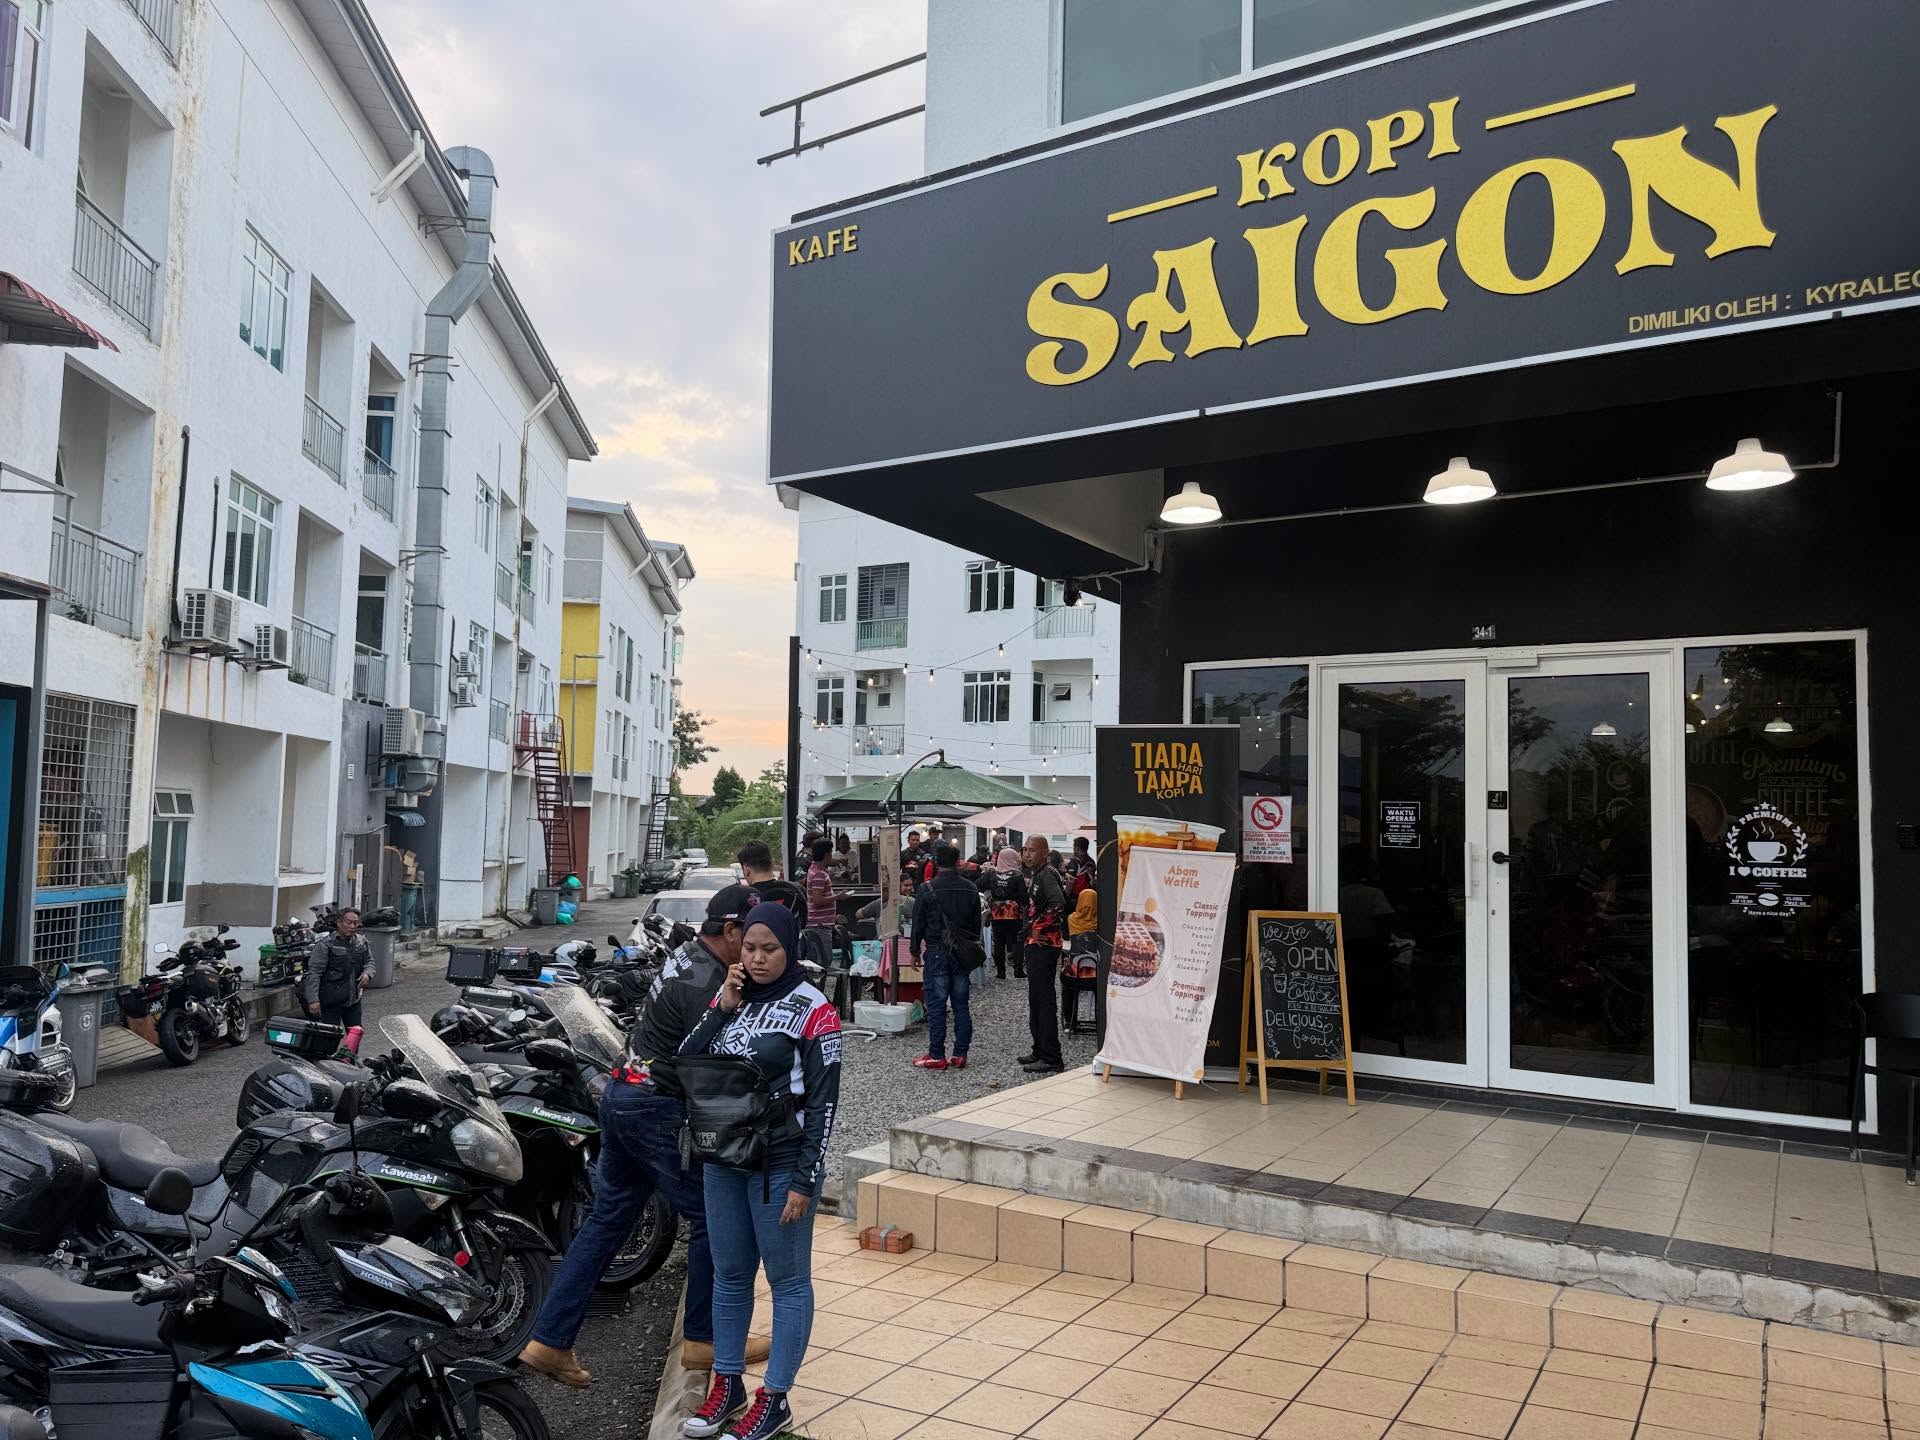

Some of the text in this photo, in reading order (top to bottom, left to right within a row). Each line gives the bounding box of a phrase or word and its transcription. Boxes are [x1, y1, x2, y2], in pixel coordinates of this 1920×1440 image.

[1236, 95, 1461, 208] KOPI
[789, 225, 858, 266] KAFE
[1025, 104, 1777, 386] SAIGON
[1629, 306, 1710, 333] DIMILIKI
[1715, 294, 1777, 320] OLEH
[1475, 626, 1492, 639] 34-1
[1131, 742, 1204, 769] TIADA
[1178, 762, 1203, 776] HARI
[1134, 770, 1204, 794] TANPA
[1156, 787, 1185, 800] KOPI
[1739, 810, 1793, 828] PREMIUM
[1168, 865, 1198, 877] Abam
[1729, 866, 1807, 878] I COFFEE
[1163, 876, 1201, 888] Waffle
[1185, 908, 1217, 919] Toppings
[1194, 901, 1219, 911] Classic
[1287, 946, 1339, 972] OPEN
[1169, 988, 1205, 1002] Toppings
[1172, 981, 1206, 993] Premium
[532, 1106, 575, 1126] Kawasaki
[809, 1102, 834, 1184] Kawasaki
[380, 1163, 438, 1185] Kawasaki
[360, 1270, 394, 1289] HONDA
